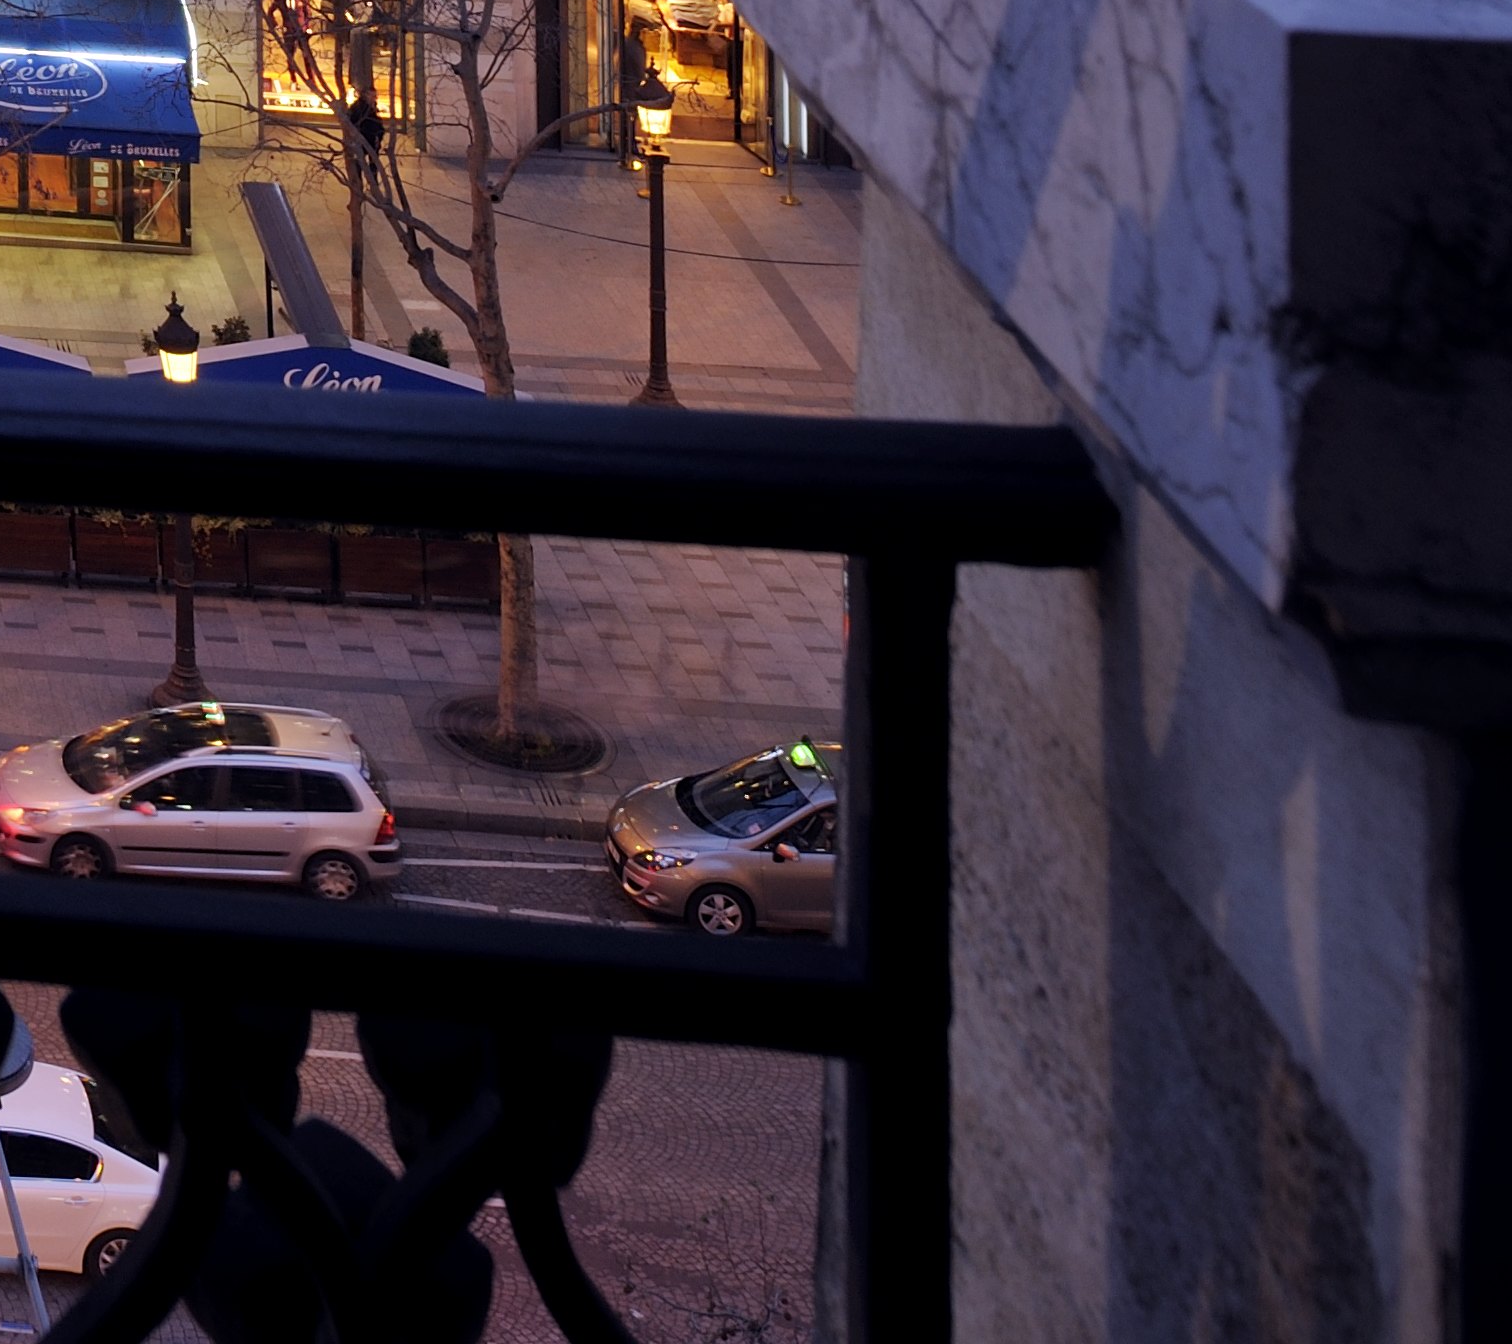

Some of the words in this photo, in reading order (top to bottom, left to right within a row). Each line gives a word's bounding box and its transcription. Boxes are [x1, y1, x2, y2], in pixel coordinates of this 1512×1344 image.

[67, 138, 102, 154] Léon
[126, 143, 180, 157] BRUXELLES
[283, 362, 383, 393] Léon
